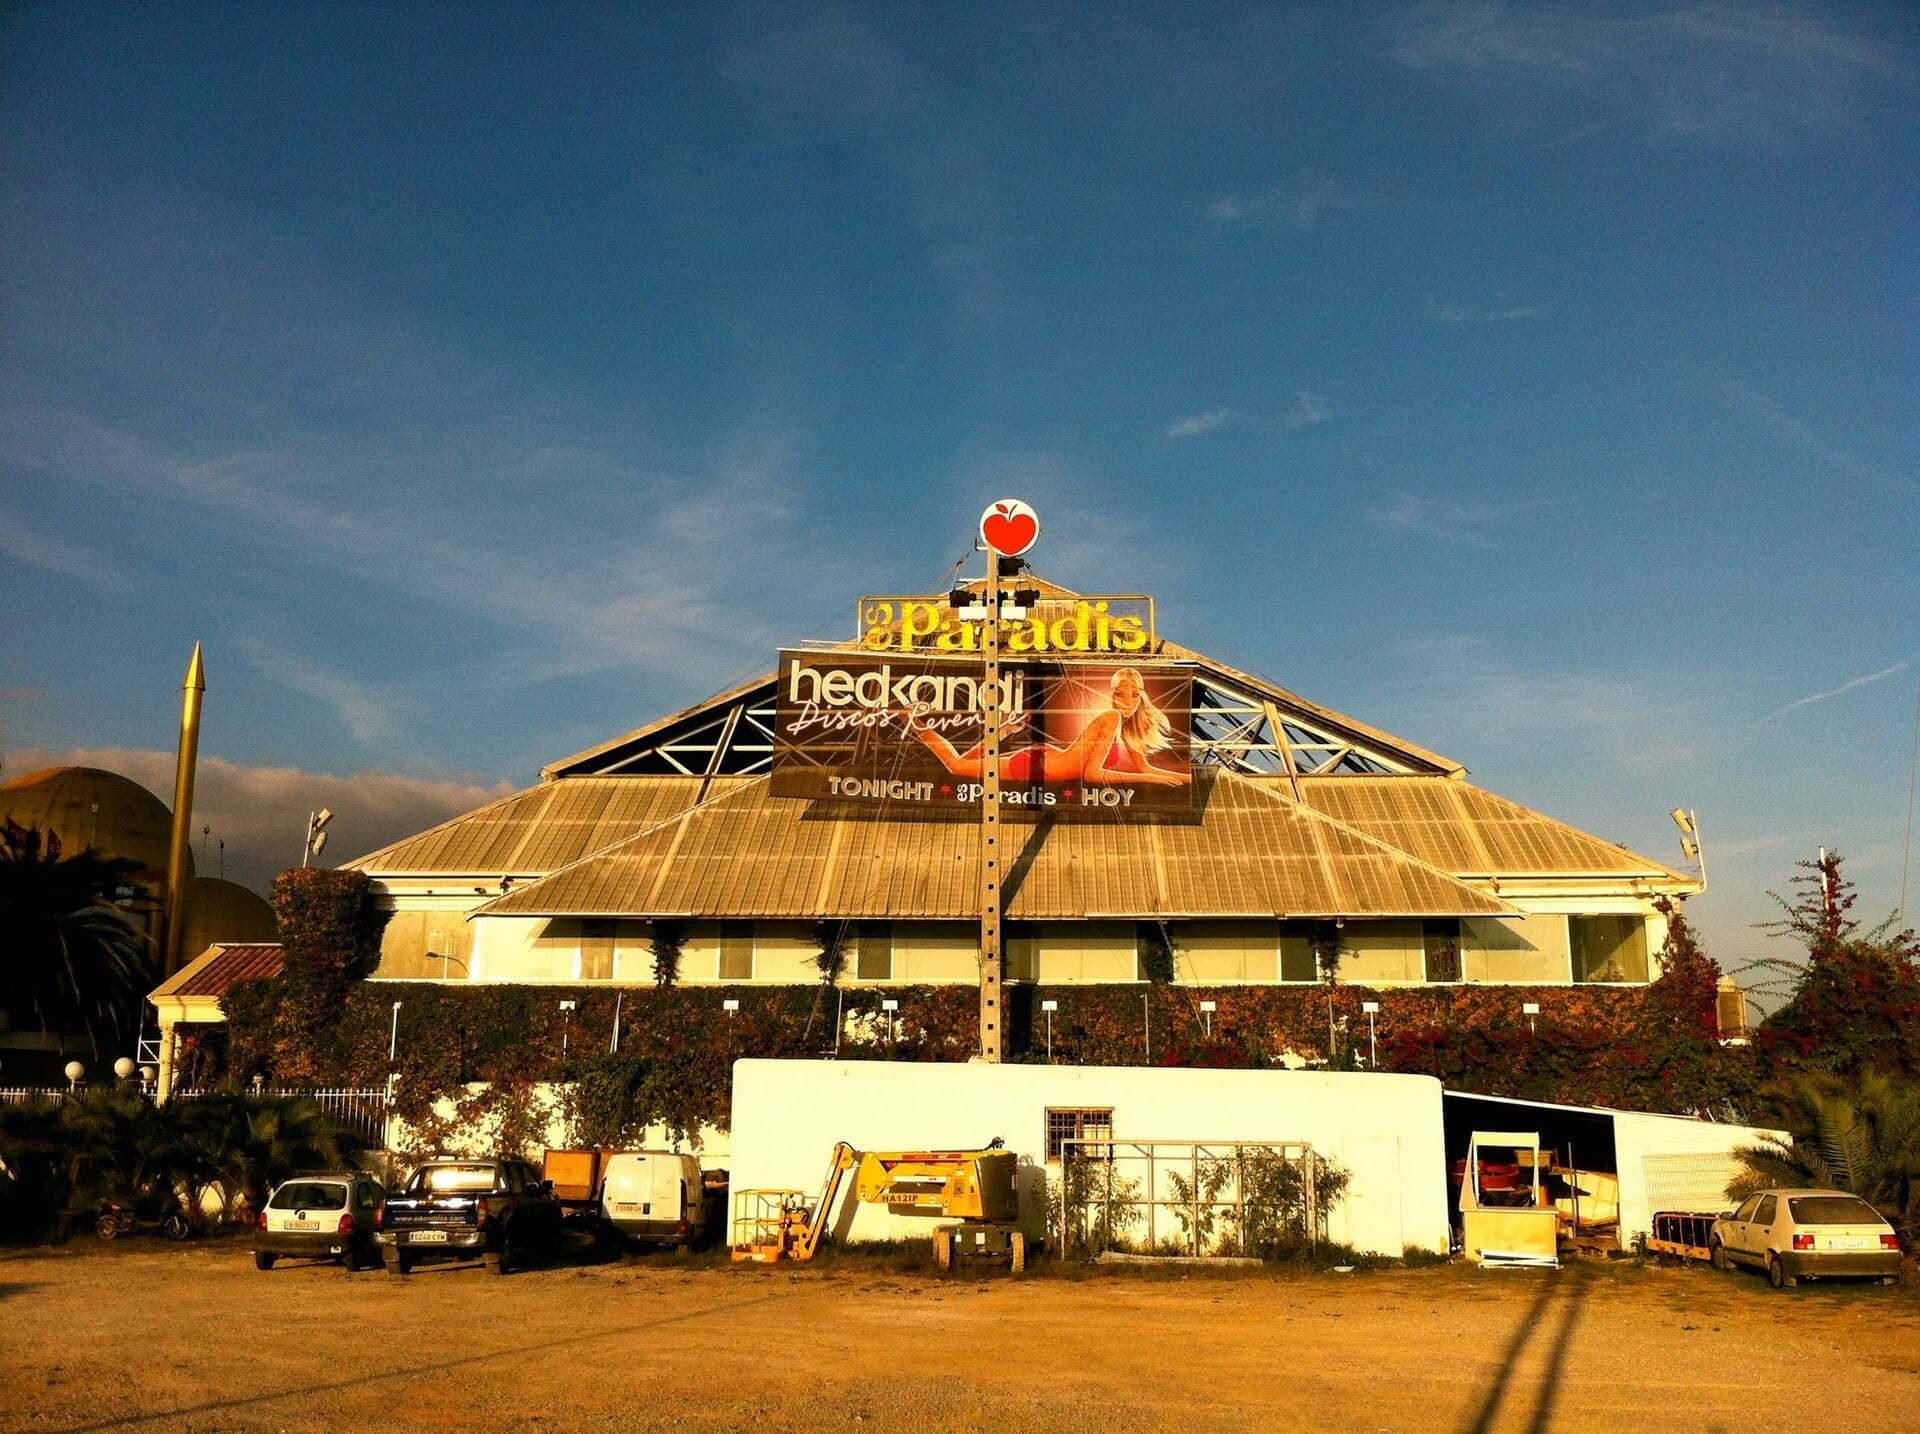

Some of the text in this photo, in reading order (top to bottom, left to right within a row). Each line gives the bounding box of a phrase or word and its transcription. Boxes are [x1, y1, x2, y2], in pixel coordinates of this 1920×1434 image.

[790, 659, 1024, 714] hedkandi
[901, 701, 1029, 740] Revene
[828, 776, 934, 801] TONIGHT
[968, 783, 1057, 806] Pradis
[1081, 788, 1135, 807] HOY
